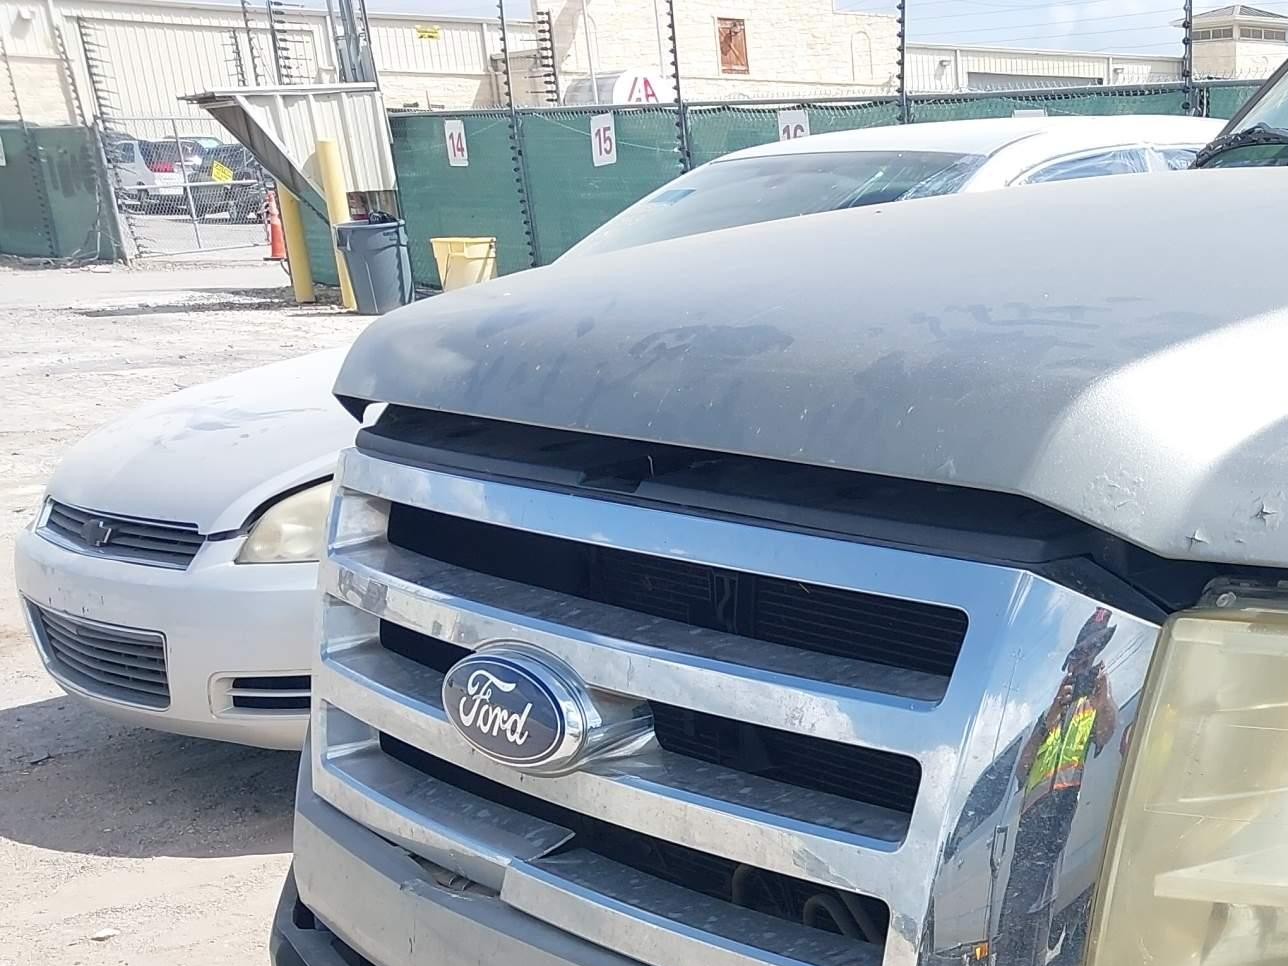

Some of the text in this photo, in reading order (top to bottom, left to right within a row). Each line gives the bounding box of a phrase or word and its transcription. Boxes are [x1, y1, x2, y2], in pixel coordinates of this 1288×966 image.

[448, 131, 464, 158] 14
[595, 126, 613, 156] 15
[459, 669, 532, 745] Ford
